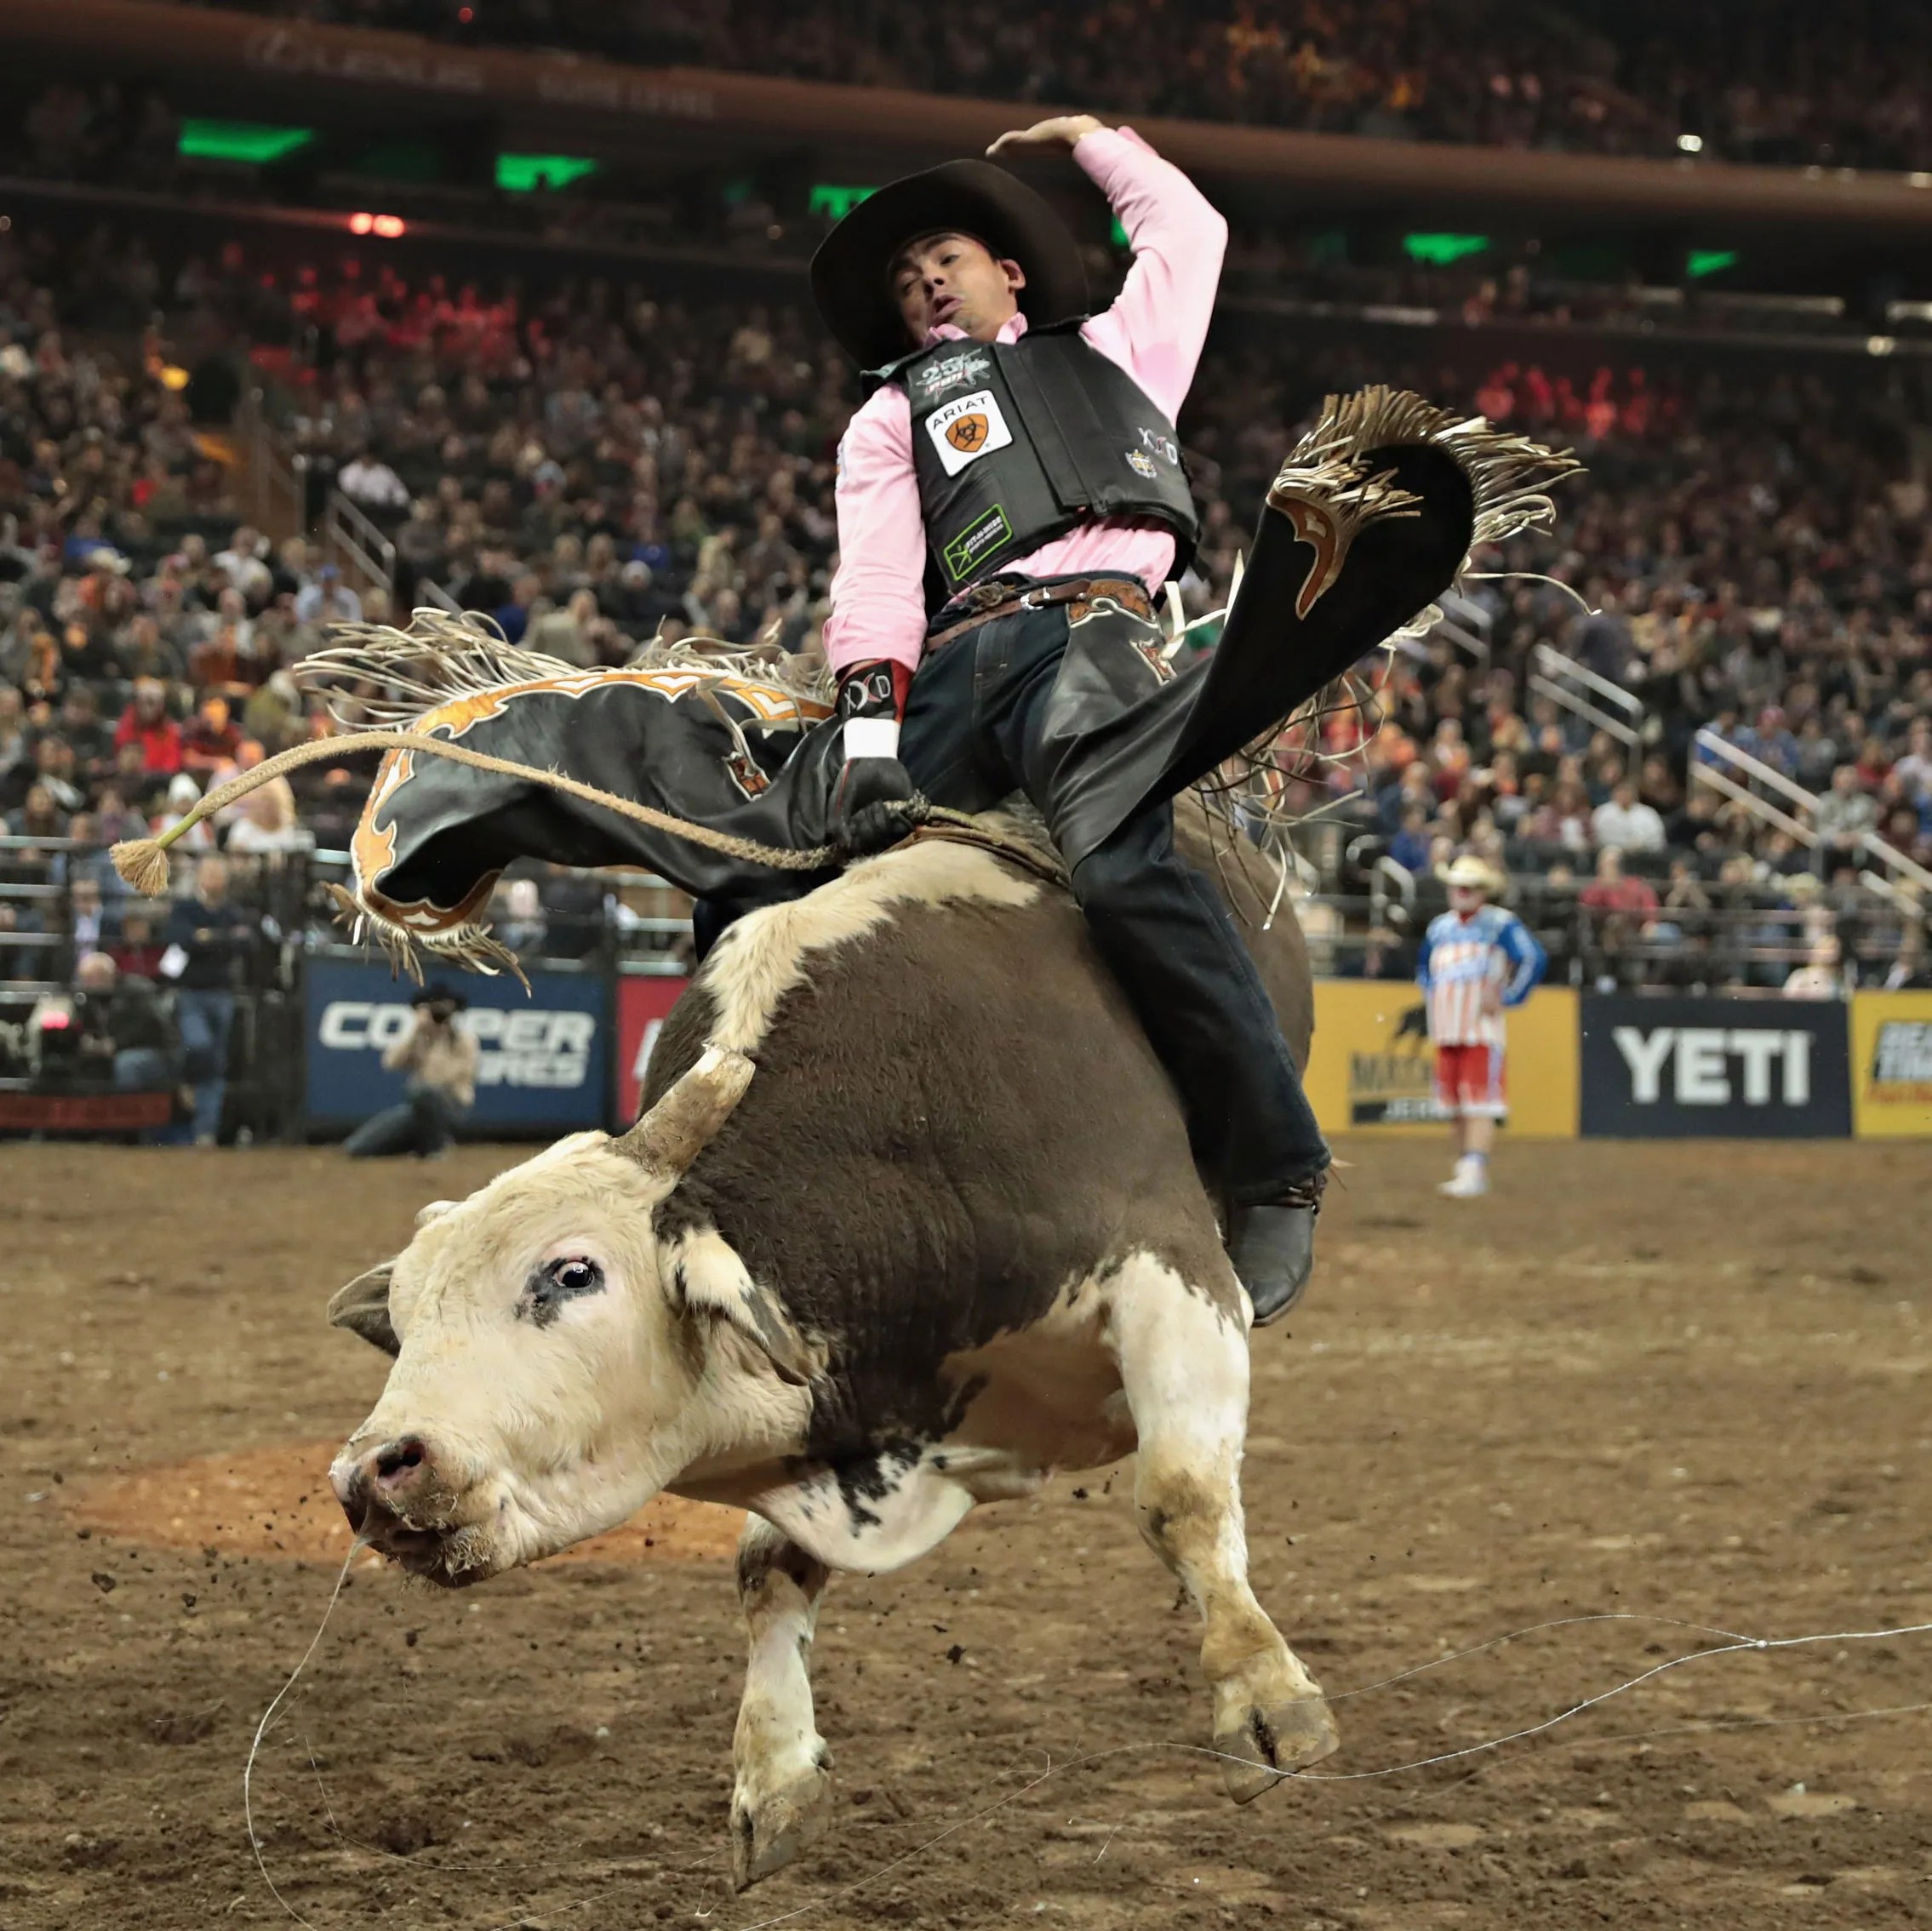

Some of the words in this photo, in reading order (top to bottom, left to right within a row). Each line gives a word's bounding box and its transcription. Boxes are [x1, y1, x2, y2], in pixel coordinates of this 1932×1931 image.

[933, 396, 987, 430] ARIAT
[319, 1001, 596, 1054] COPER
[1613, 1026, 1809, 1106] YETI
